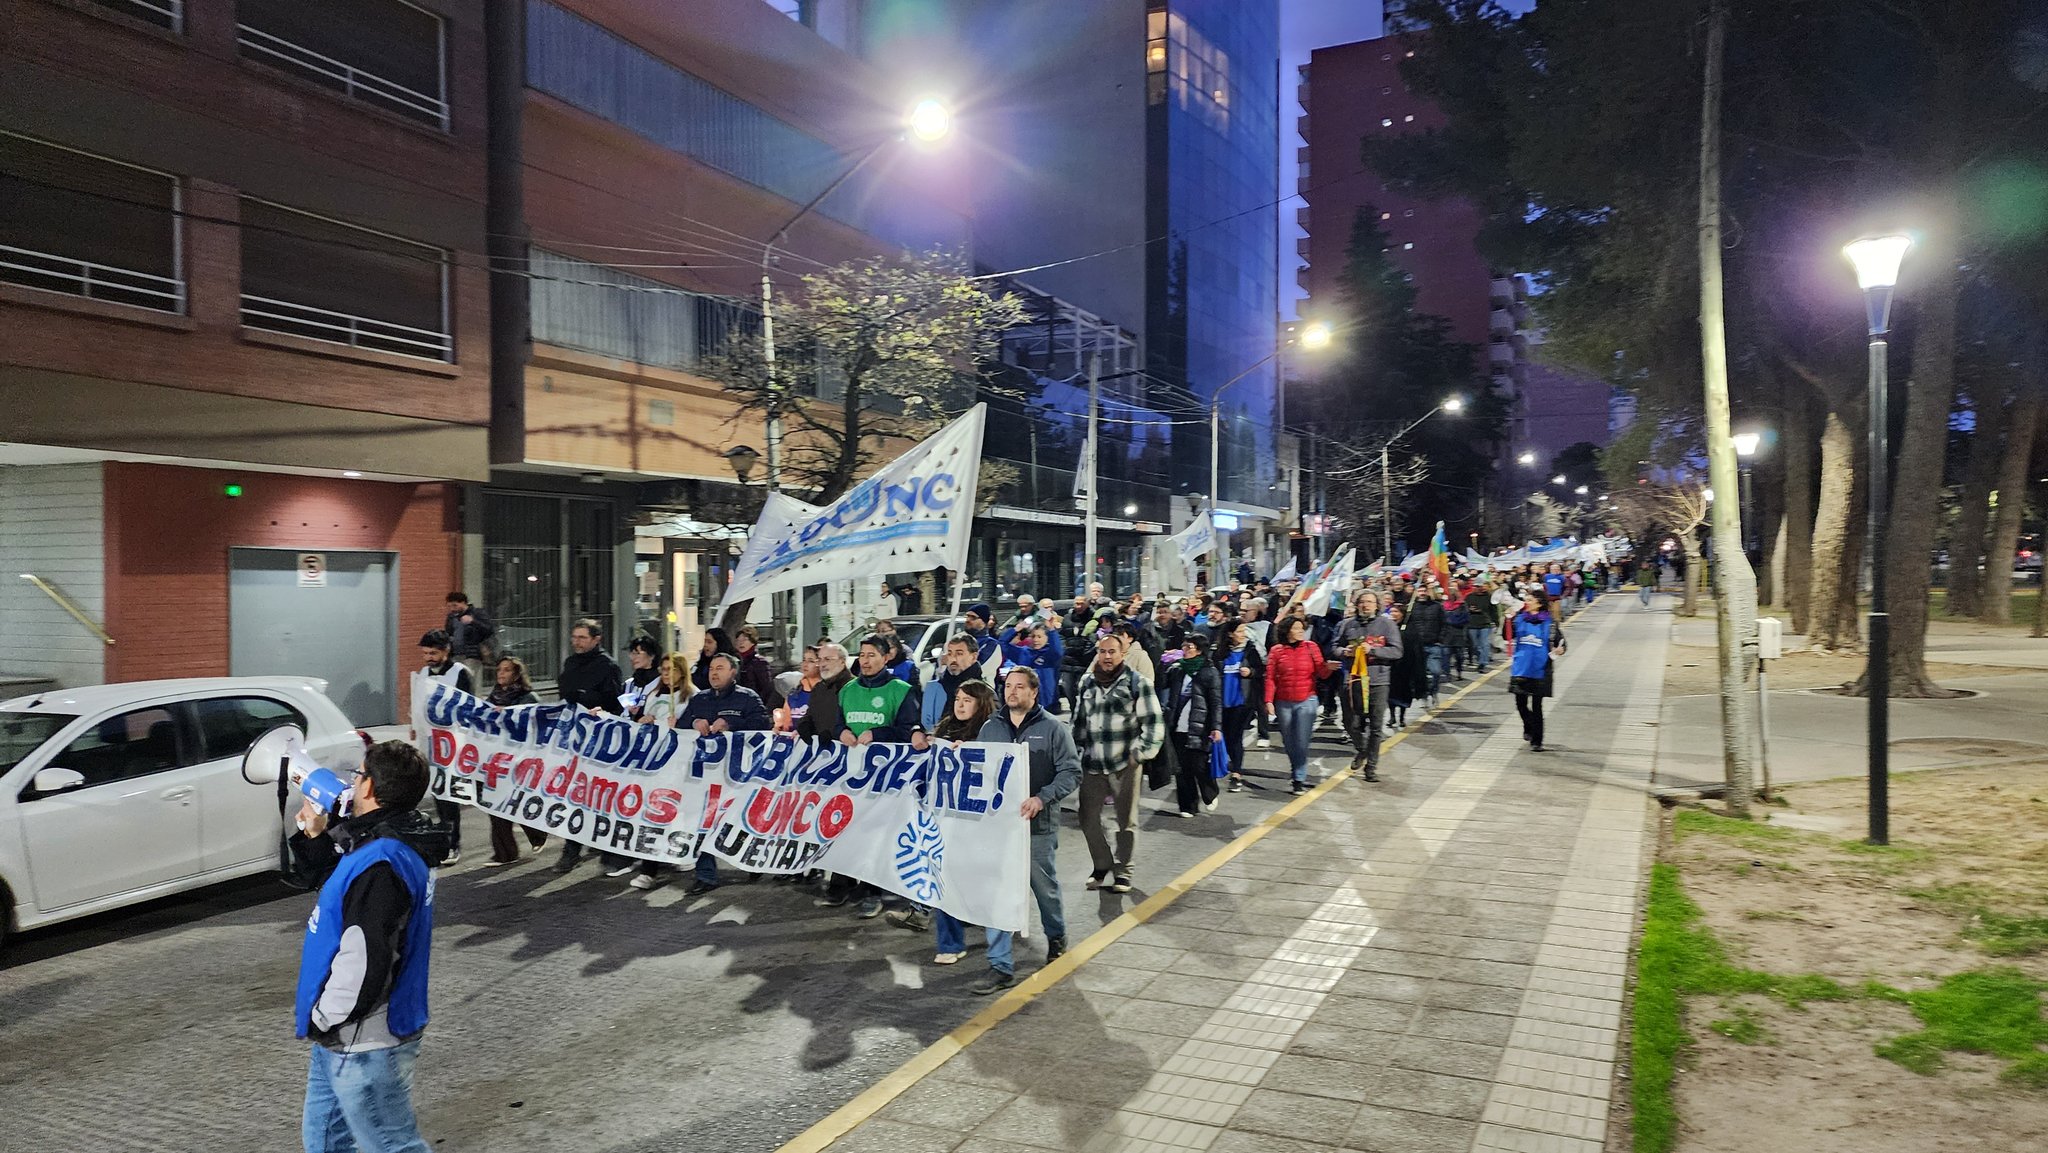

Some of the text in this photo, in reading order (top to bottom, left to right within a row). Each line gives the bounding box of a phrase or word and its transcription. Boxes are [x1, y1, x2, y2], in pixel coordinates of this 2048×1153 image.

[430, 729, 683, 825] Defndamos
[744, 786, 854, 840] UNCO
[431, 768, 493, 809] DEL
[494, 789, 584, 834] HOGO
